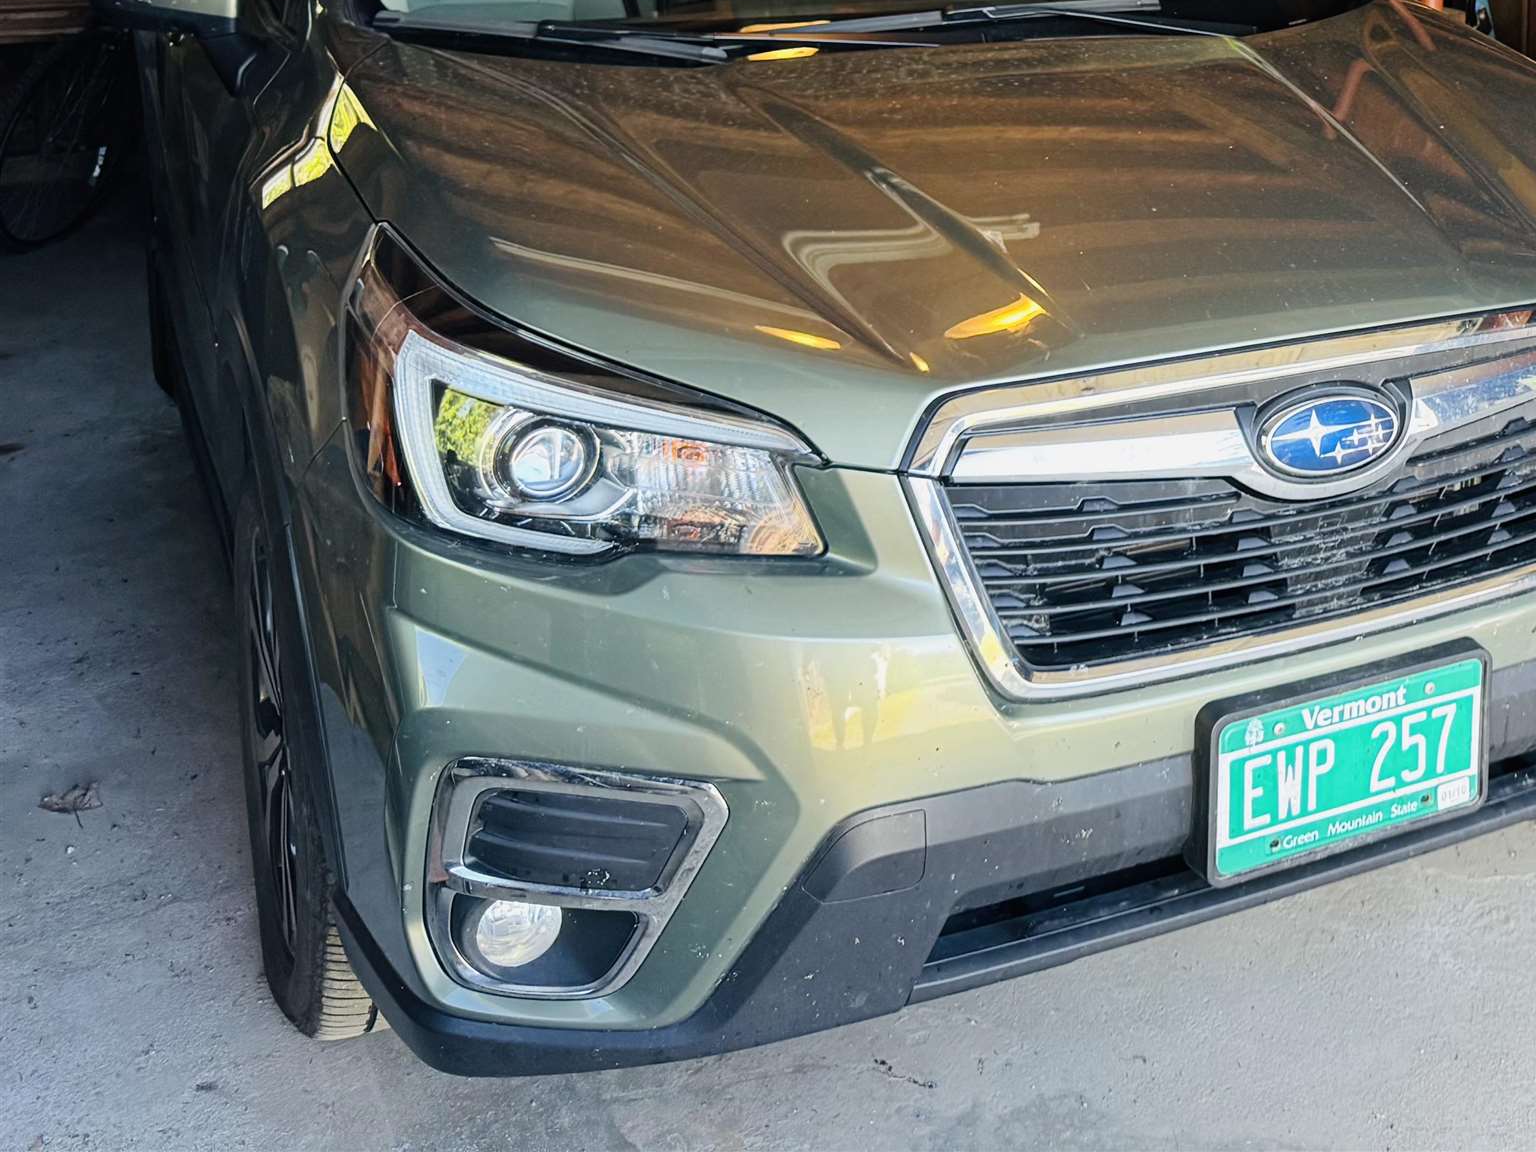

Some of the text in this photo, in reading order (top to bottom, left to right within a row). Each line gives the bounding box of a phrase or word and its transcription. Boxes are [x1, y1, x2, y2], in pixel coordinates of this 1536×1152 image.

[1302, 684, 1407, 730] Vermont
[1243, 702, 1457, 831] EWP 257
[1282, 800, 1418, 850] Green Mountain State
